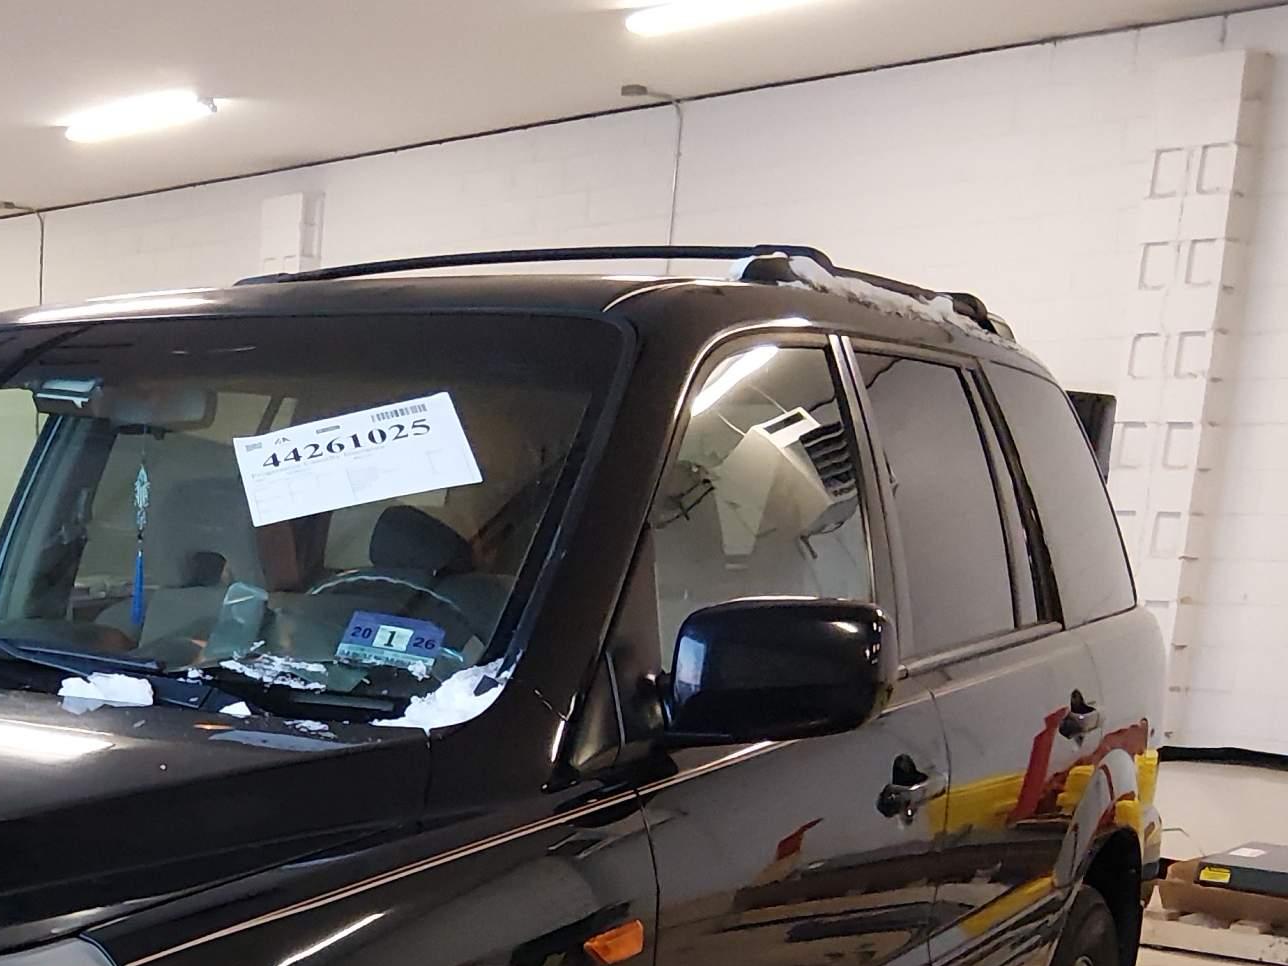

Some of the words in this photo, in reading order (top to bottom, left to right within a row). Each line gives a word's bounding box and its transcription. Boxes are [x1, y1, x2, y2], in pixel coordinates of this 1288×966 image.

[262, 418, 431, 468] 44261025
[351, 626, 372, 639] 20
[383, 630, 396, 648] 1
[412, 637, 436, 650] 26
